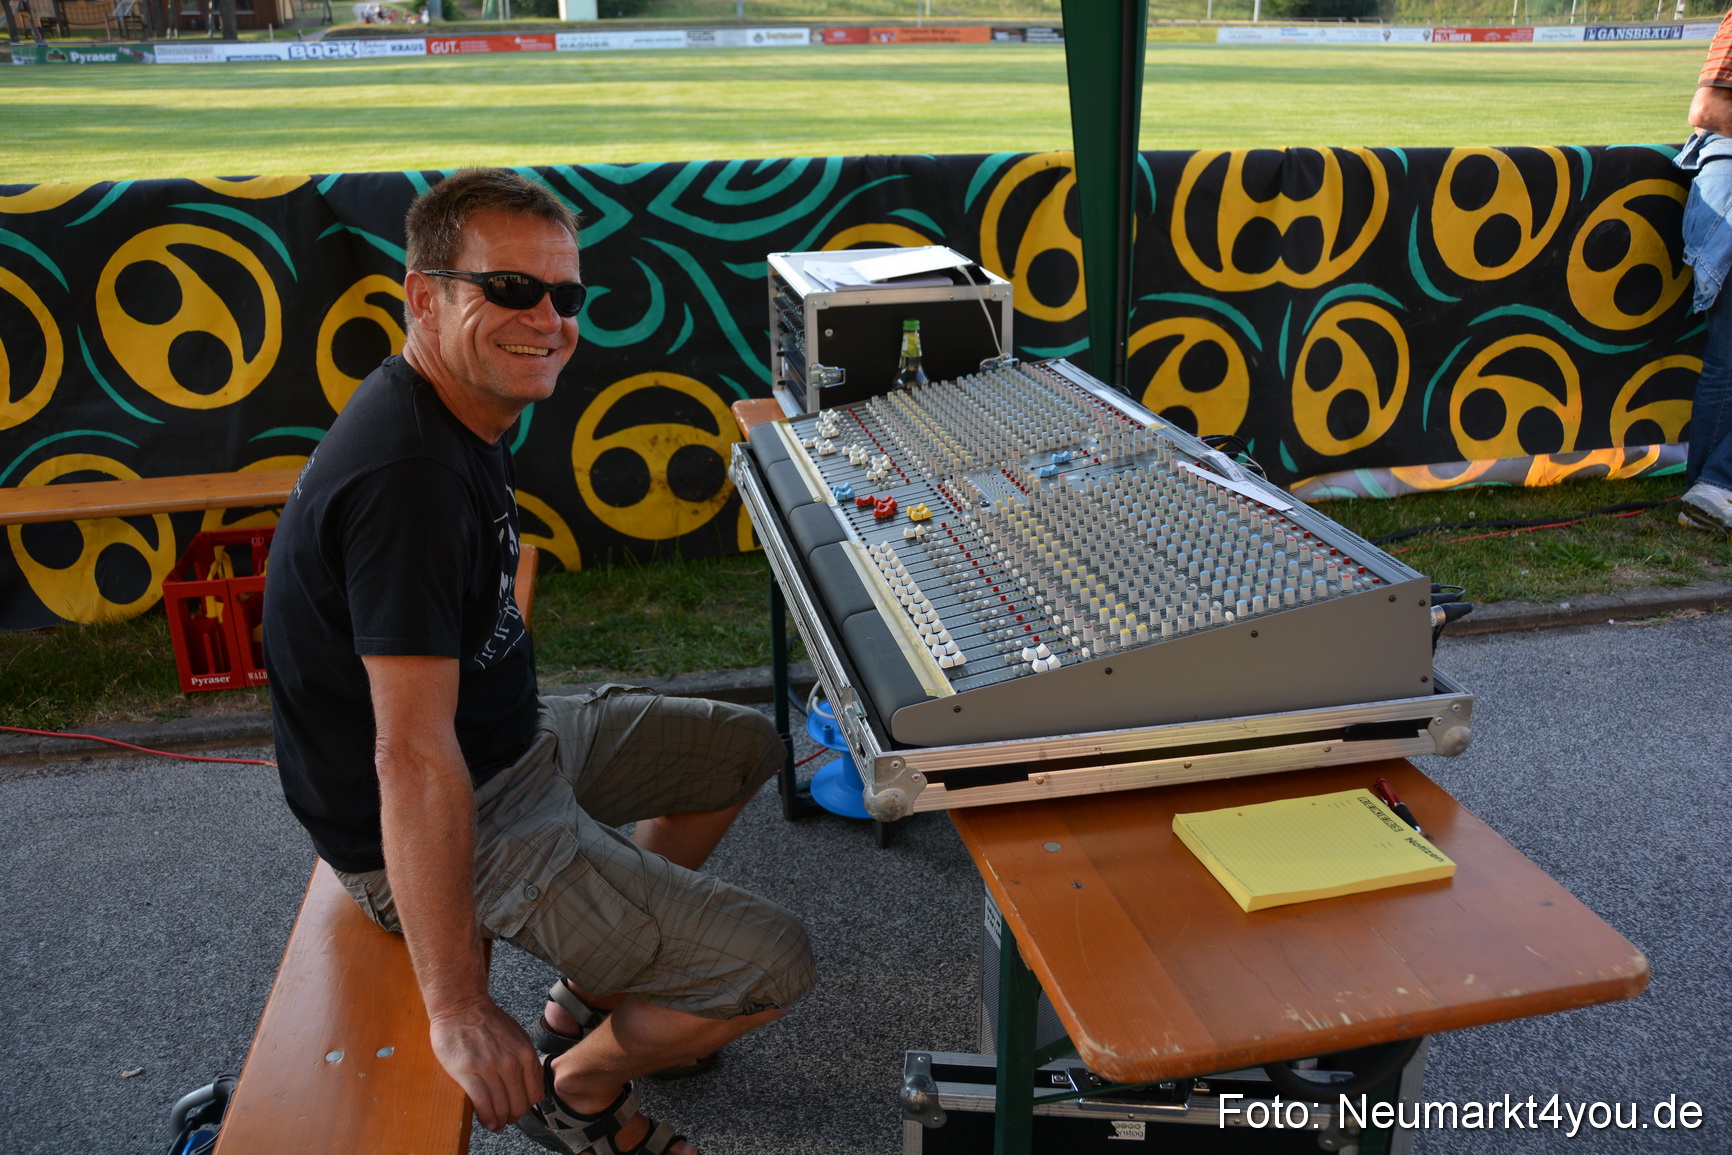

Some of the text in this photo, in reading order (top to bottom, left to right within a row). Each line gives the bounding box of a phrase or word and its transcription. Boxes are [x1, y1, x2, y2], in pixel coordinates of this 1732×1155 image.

[1597, 28, 1670, 40] GANSBRÄU
[288, 42, 358, 60] BOCK
[430, 41, 460, 54] GUT.
[70, 51, 117, 64] Pyraser
[190, 676, 231, 687] Pyraser
[1404, 837, 1445, 862] Notizen
